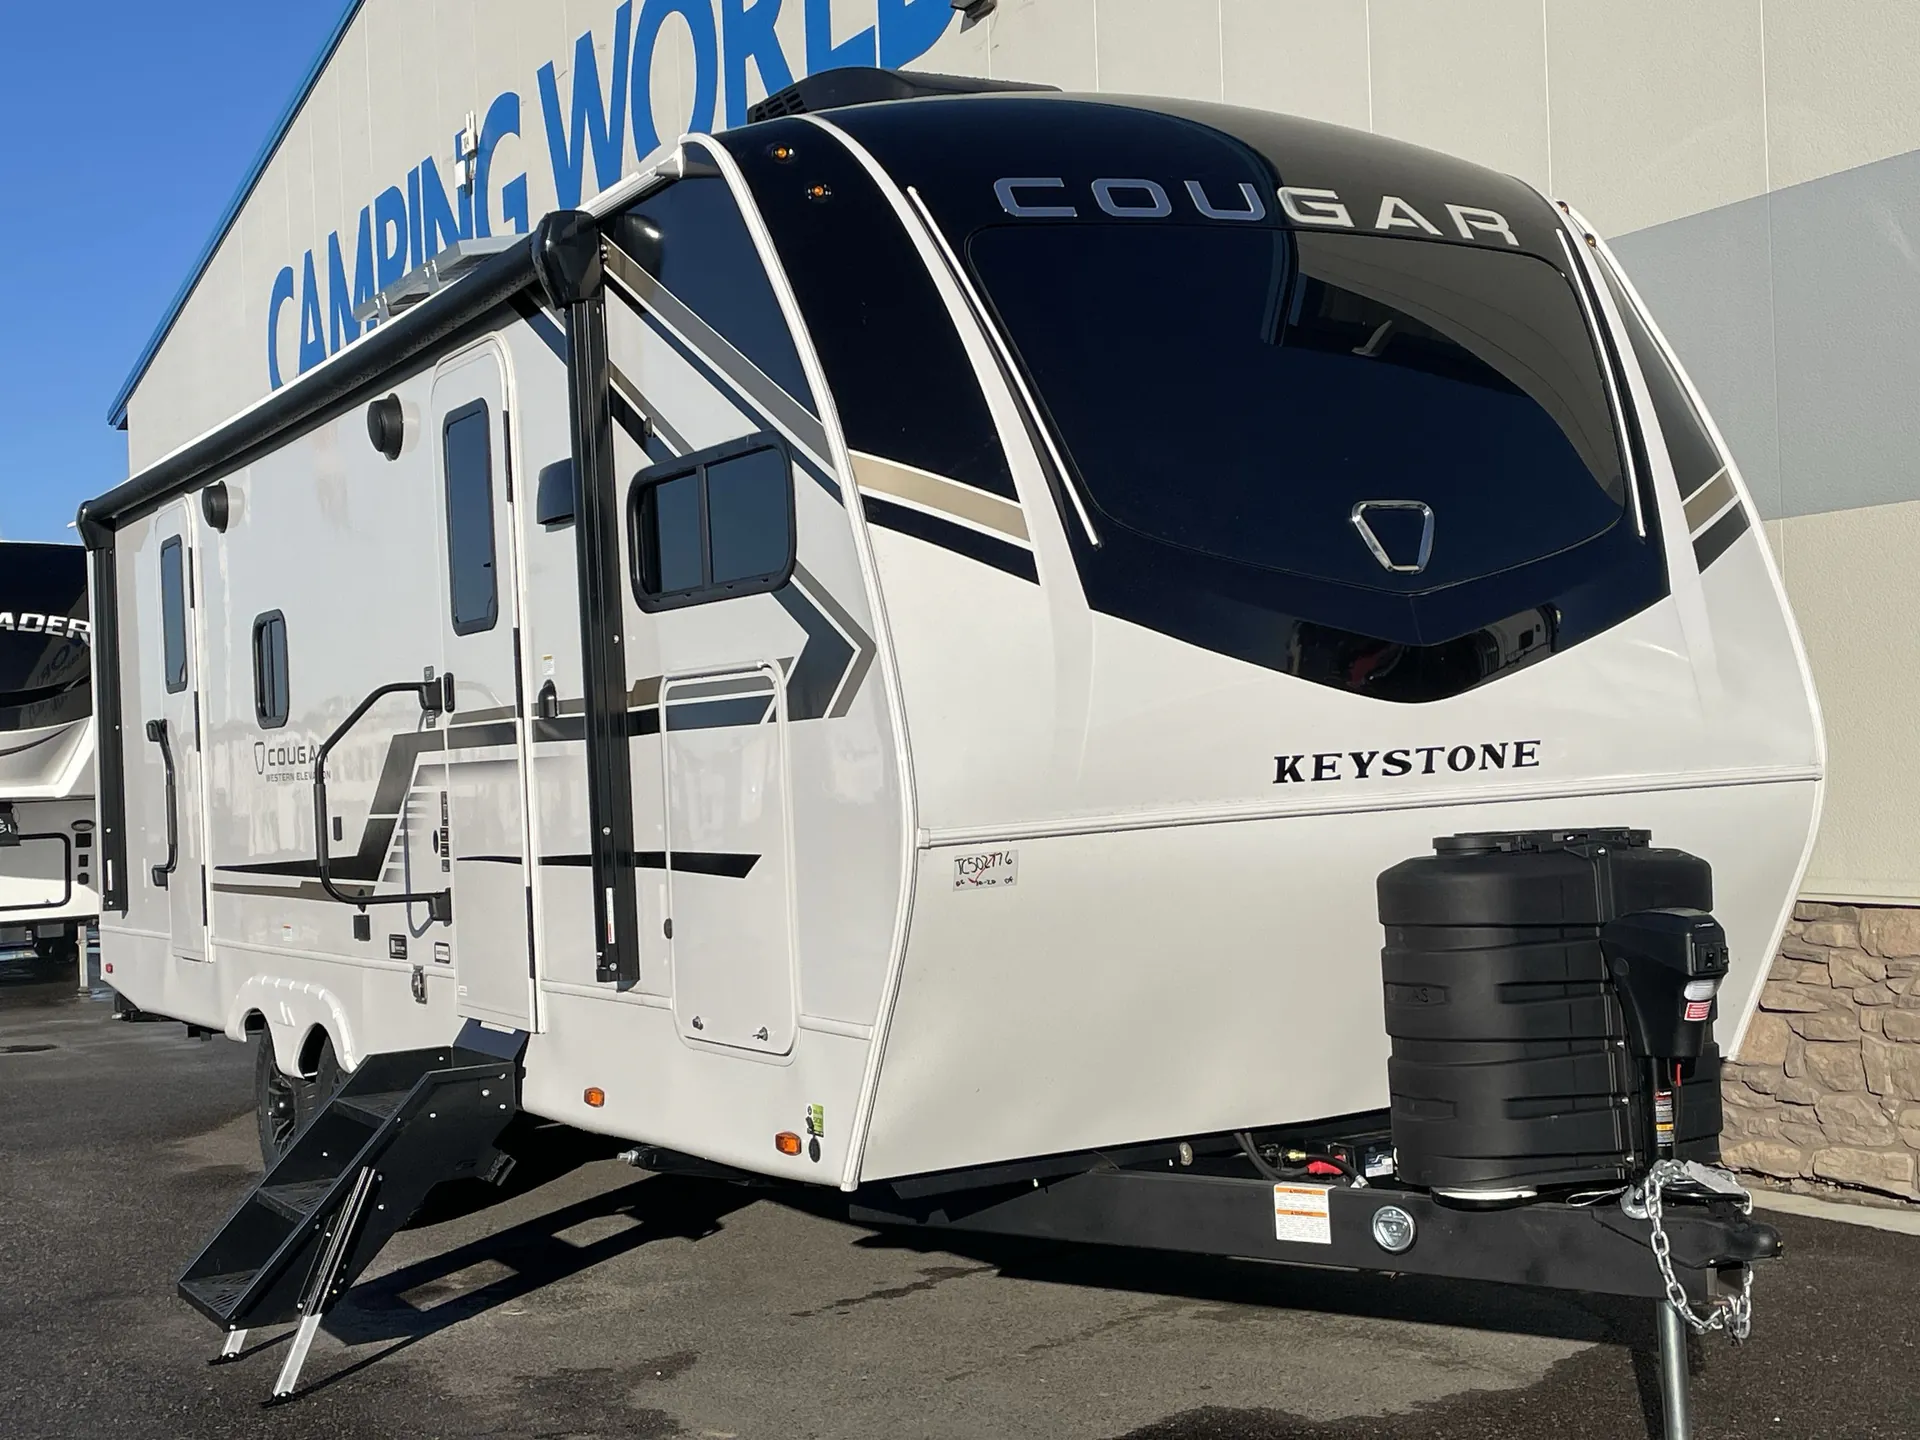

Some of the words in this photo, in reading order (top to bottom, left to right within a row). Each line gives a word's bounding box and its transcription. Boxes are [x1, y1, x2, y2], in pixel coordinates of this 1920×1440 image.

[993, 177, 1520, 246] COUGAR
[268, 92, 530, 392] CAMPING
[296, 770, 331, 781] ELEVON
[1272, 740, 1541, 784] KEYSTONE
